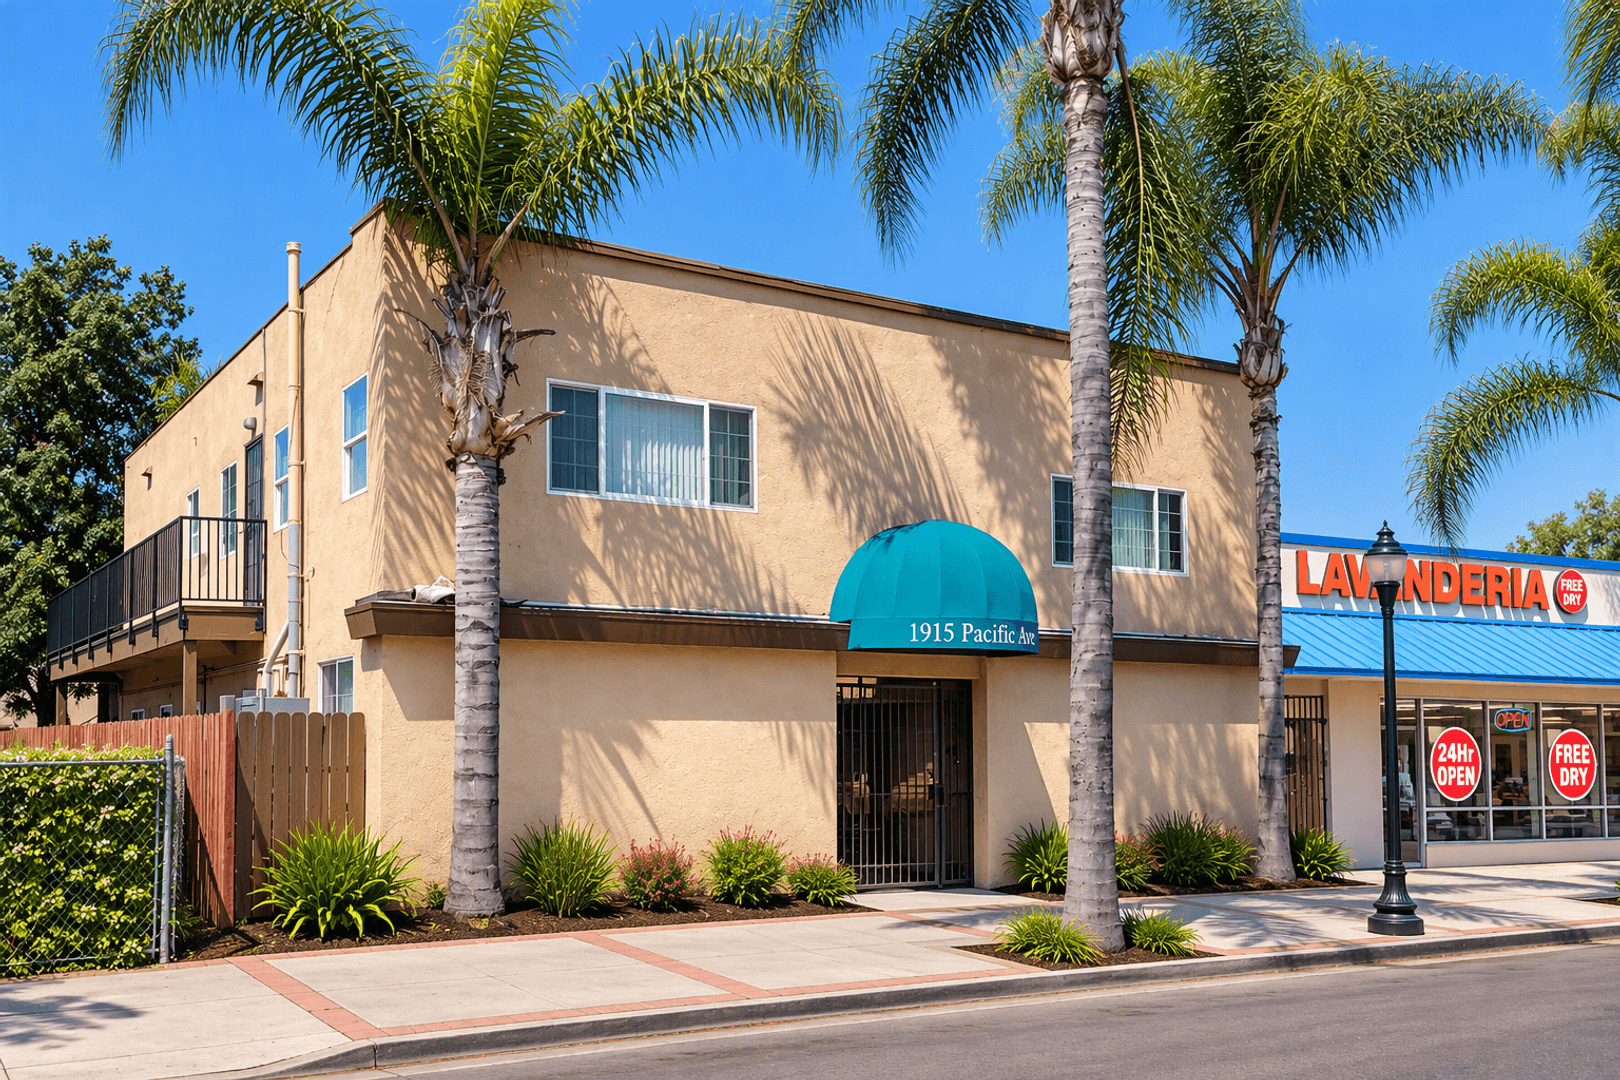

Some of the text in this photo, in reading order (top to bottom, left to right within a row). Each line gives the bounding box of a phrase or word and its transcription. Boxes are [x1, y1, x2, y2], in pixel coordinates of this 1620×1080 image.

[1296, 550, 1549, 610] LAVNDERIA
[1561, 578, 1583, 593] FREE
[1563, 593, 1581, 606] DRY
[910, 623, 954, 642] 1915
[961, 623, 1015, 643] Pacific
[1496, 712, 1530, 728] OPEN
[1438, 743, 1474, 762] 24Hr
[1555, 744, 1590, 764] FREE
[1437, 766, 1475, 786] OPEN
[1560, 767, 1588, 786] DRY
